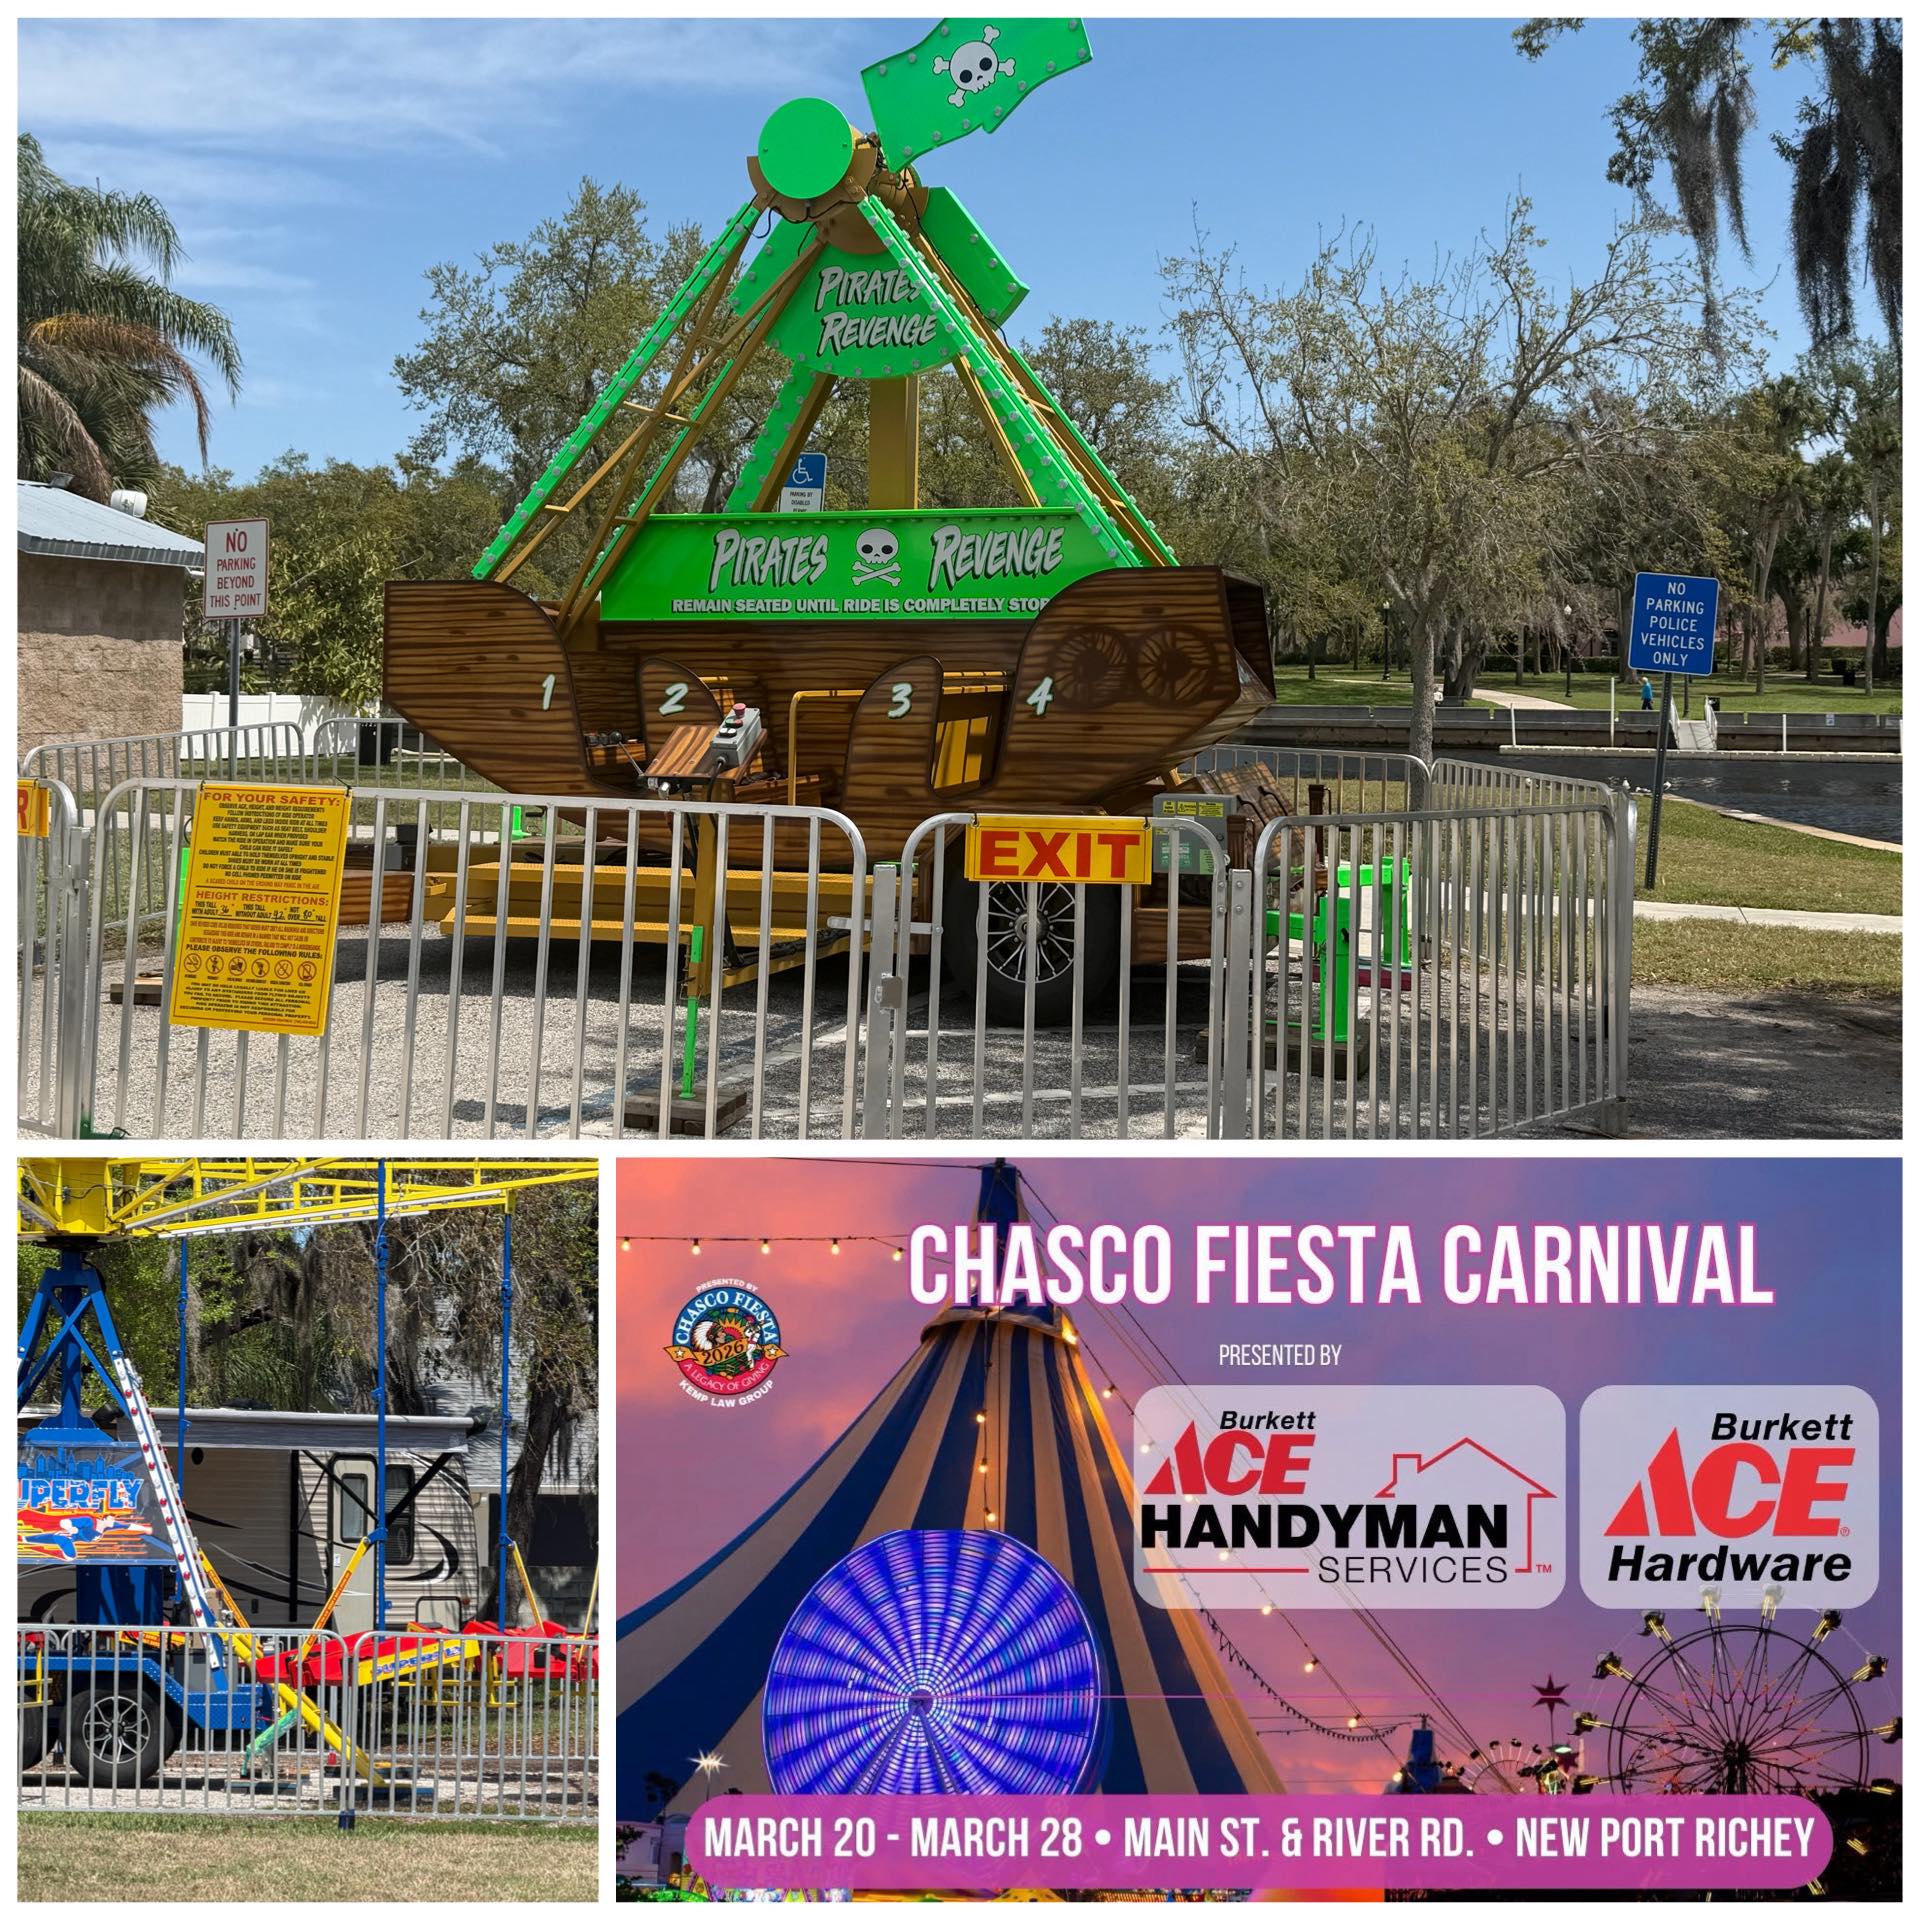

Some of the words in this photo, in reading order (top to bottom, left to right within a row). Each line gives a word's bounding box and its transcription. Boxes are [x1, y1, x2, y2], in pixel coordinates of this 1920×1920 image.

[817, 311, 937, 357] REVENGE
[226, 531, 247, 552] NO
[217, 557, 256, 571] PARKING
[708, 528, 829, 593] PIRATES
[928, 525, 1065, 592] REVENGE
[217, 575, 255, 589] BEYOND
[1667, 582, 1686, 595] NO
[210, 594, 230, 607] THIS
[234, 593, 262, 607] POINT
[672, 599, 732, 614] REMAIN
[735, 599, 792, 613] SEATED
[797, 599, 839, 614] UNTIL
[843, 598, 880, 613] RIDE
[884, 598, 899, 613] IS
[904, 598, 1004, 613] COMPLETELY
[1646, 597, 1704, 615] PARKING
[1649, 615, 1698, 632] POLICE
[1641, 632, 1704, 650] VEHICLES
[1653, 651, 1688, 666] ONLY
[541, 672, 556, 711] 1
[657, 682, 689, 717] 2
[887, 682, 913, 719] 3
[1026, 676, 1054, 716] 4
[203, 791, 232, 801] FOR
[235, 793, 275, 803] YOUR
[279, 794, 340, 806] SAFETY:
[980, 830, 1140, 878] EXIT
[196, 890, 238, 900] HEIGHT
[241, 893, 328, 906] RESTRICTIONS:
[185, 943, 211, 951] PLEASE
[211, 945, 242, 954] OBSERVE
[243, 947, 256, 955] THE
[257, 948, 297, 958] FOLLOWING
[298, 951, 322, 960] RULES:
[910, 1224, 1172, 1305] CHASCO
[1196, 1224, 1422, 1305] FIESTA
[1443, 1224, 1775, 1305] CARNIVAL
[696, 1278, 745, 1293] PRESENTED
[746, 1283, 758, 1292] BY
[675, 1290, 729, 1345] CHASCO
[733, 1291, 778, 1342] FIESTA
[701, 1340, 745, 1365] 2026
[1219, 1344, 1315, 1366] PRESENTED
[1320, 1344, 1342, 1366] BY
[684, 1363, 692, 1371] A
[691, 1369, 725, 1391] LEGACY
[727, 1382, 740, 1391] OF
[741, 1362, 769, 1387] GIVING
[678, 1379, 709, 1402] KEMP
[710, 1397, 736, 1407] LAW
[738, 1379, 774, 1406] GROUP
[1219, 1410, 1316, 1431] Burkett
[1711, 1412, 1853, 1441] Burkett
[1143, 1419, 1316, 1496] ACE
[1603, 1426, 1856, 1538] ACE
[1141, 1504, 1508, 1548] HANDYMAN
[1318, 1556, 1508, 1583] SERVICES
[1608, 1545, 1852, 1582] Hardware
[704, 1816, 822, 1858] MARCH
[834, 1816, 876, 1858] 20
[911, 1816, 1029, 1858] MARCH
[1040, 1816, 1082, 1858] 28
[1123, 1816, 1209, 1858] MAIN
[1220, 1816, 1269, 1858] ST.
[1281, 1816, 1303, 1858] &
[1312, 1816, 1409, 1858] RIVER
[1420, 1816, 1474, 1858] RD.
[1516, 1816, 1589, 1858] NEW
[1601, 1816, 1684, 1858] PORT
[1695, 1816, 1816, 1858] RICHEY
